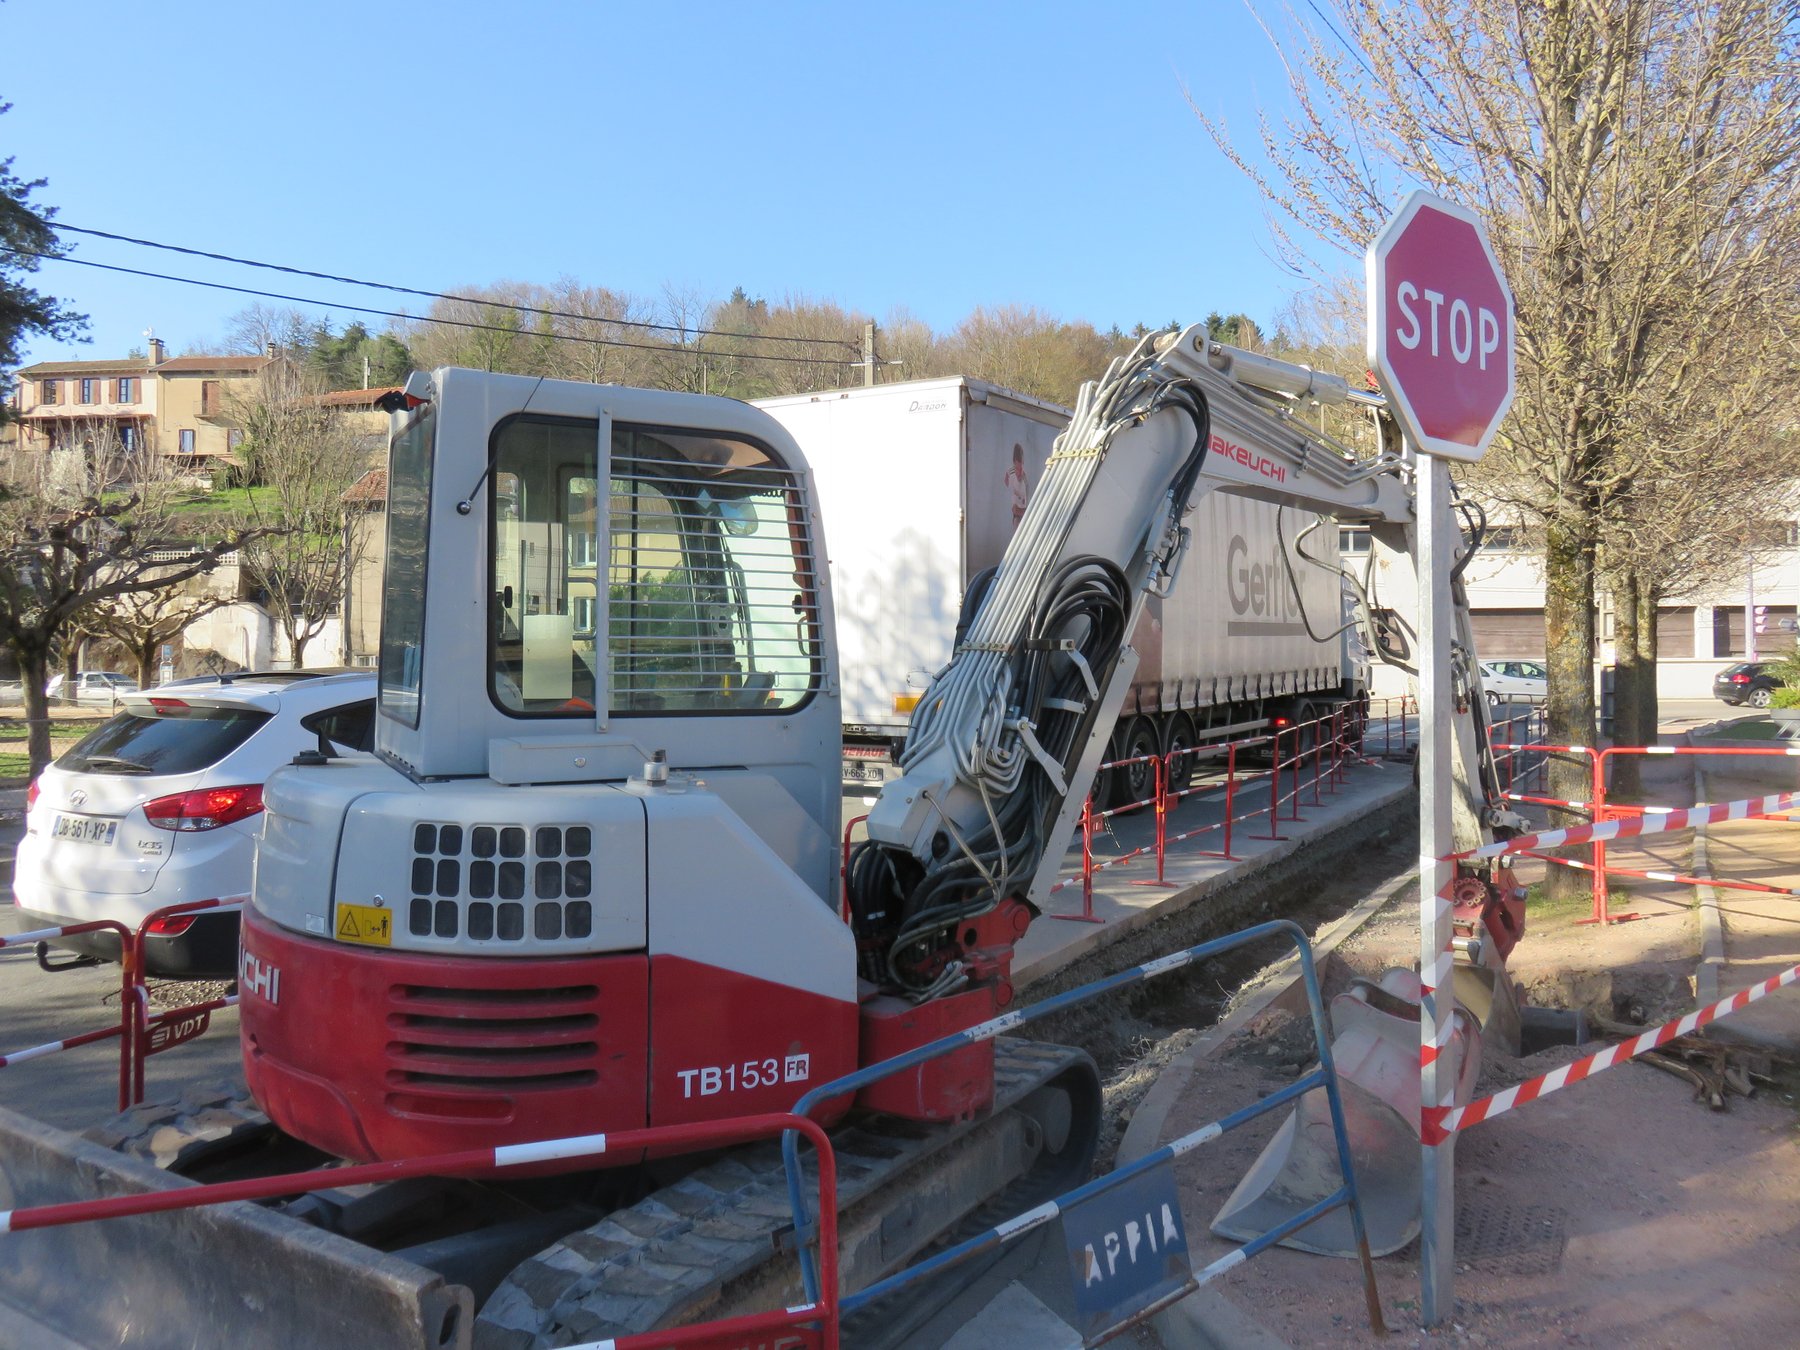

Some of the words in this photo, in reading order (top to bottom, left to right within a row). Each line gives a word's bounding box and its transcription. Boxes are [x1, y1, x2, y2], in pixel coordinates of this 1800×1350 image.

[1396, 280, 1499, 371] STOP
[173, 1013, 206, 1040] VDT
[677, 1058, 779, 1098] TB153
[785, 1057, 808, 1079] FR
[1084, 1203, 1180, 1288] APPIA
